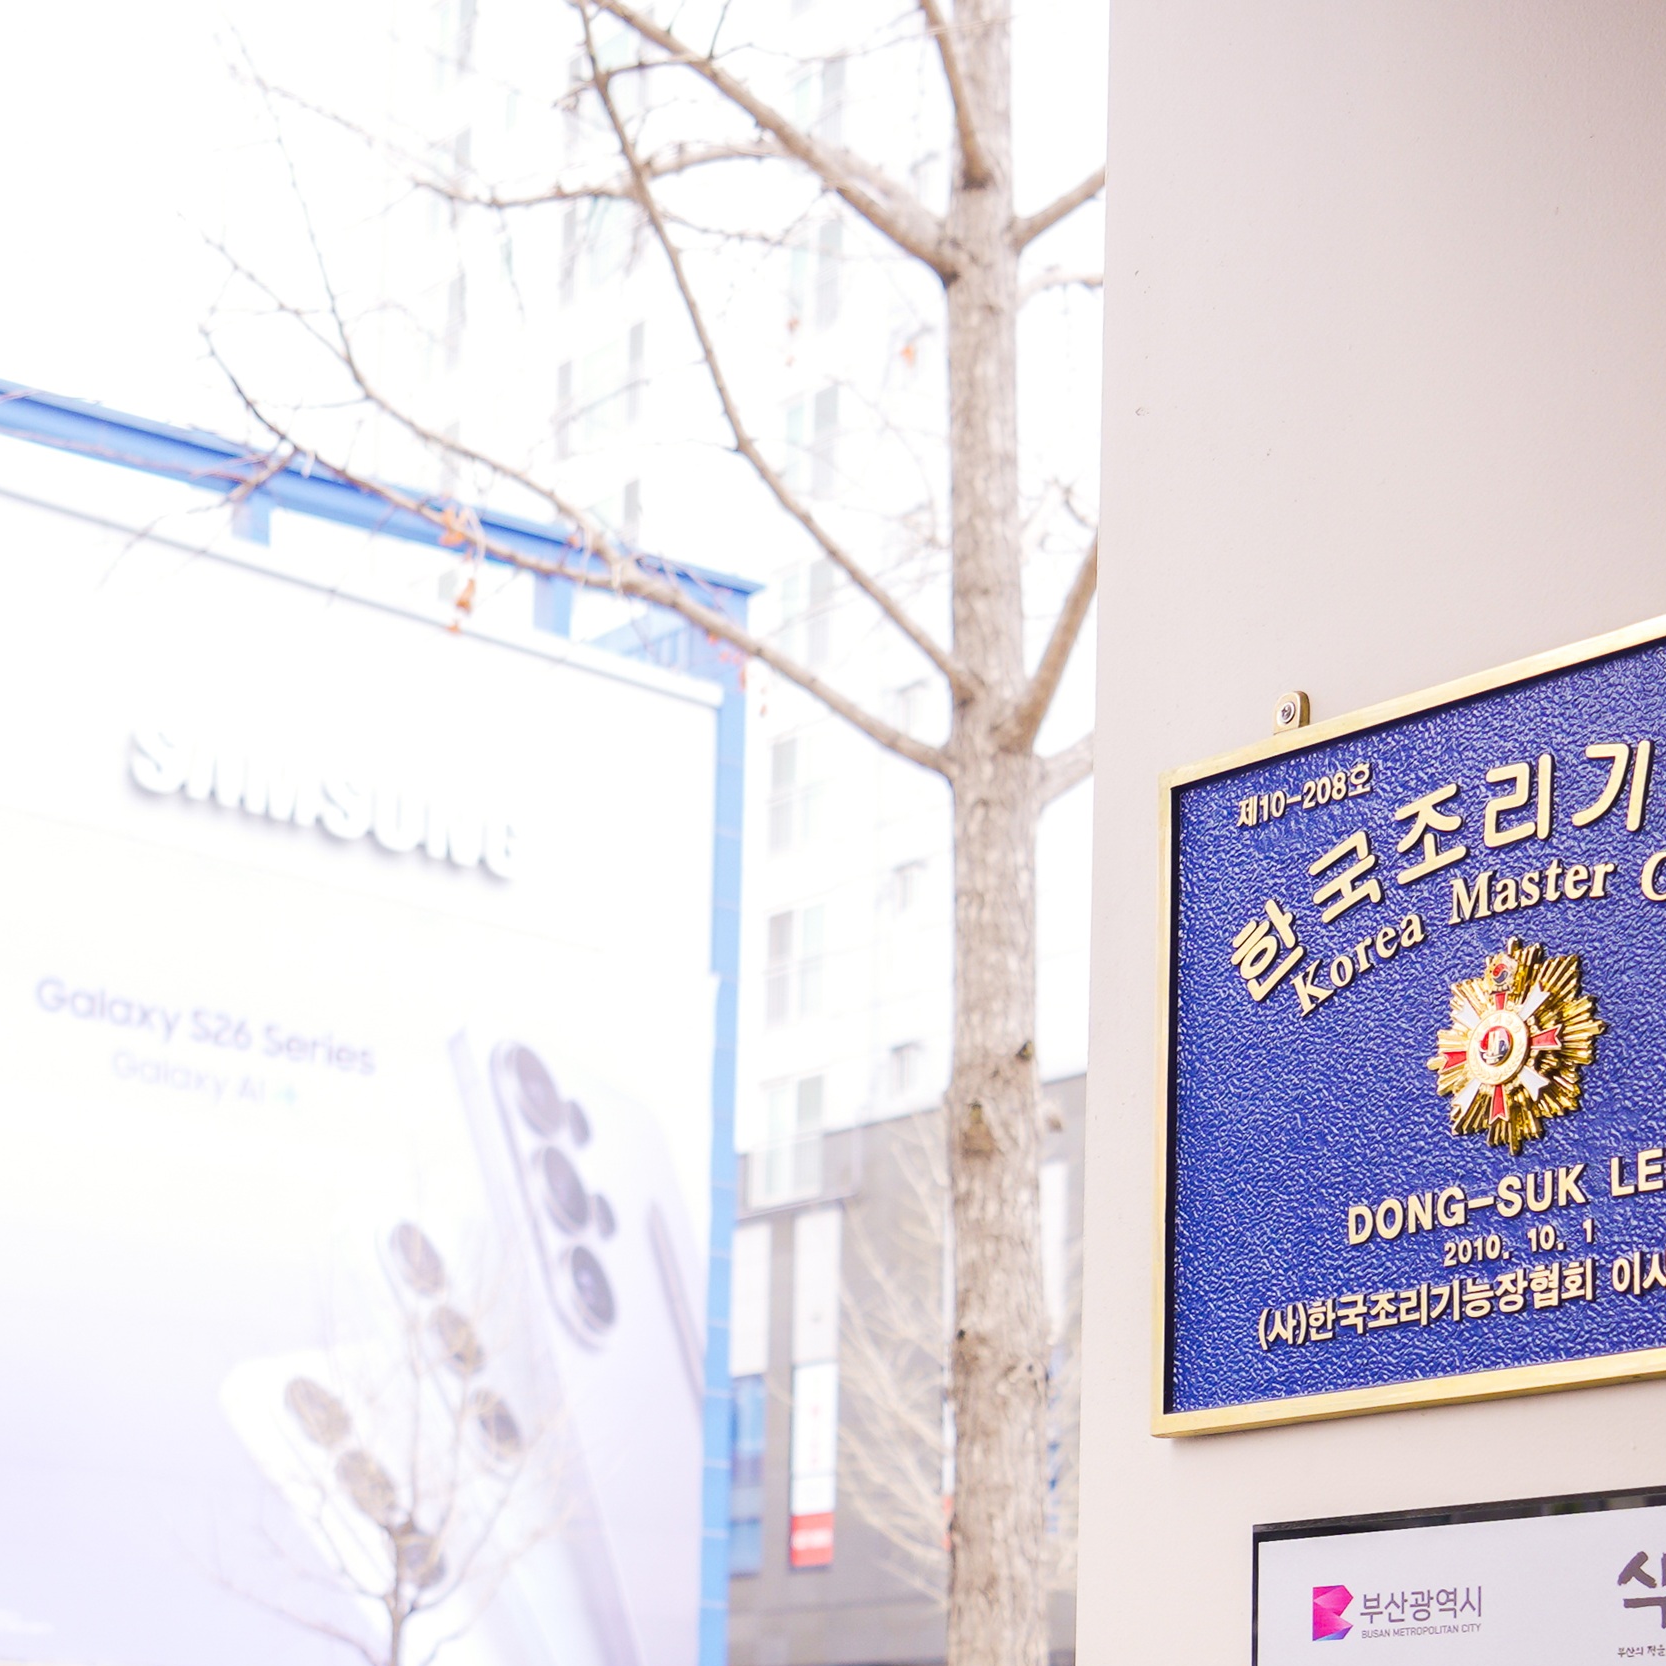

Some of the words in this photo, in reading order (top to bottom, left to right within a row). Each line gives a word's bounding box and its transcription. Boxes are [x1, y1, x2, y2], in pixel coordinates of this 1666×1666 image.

[128, 726, 521, 882] SAMSUNG
[1237, 762, 1374, 828] 제10-208호
[1293, 912, 1425, 1018] Korea
[1448, 856, 1618, 926] Master
[35, 975, 181, 1044] Galaxy
[189, 1006, 253, 1053] S26
[262, 1022, 378, 1077] Series
[111, 1048, 229, 1104] Galaxy
[236, 1075, 266, 1105] AI
[1347, 1162, 1588, 1246] DONG-SUK
[1443, 1235, 1512, 1267] 2010.
[1526, 1225, 1566, 1255] 10.
[1582, 1217, 1595, 1245] 1
[1257, 1258, 1596, 1352] (사)한국조리기능장협회
[1359, 1585, 1482, 1625] 부산광역시
[1361, 1628, 1391, 1639] BUSAN
[1392, 1624, 1459, 1637] METROPOLITAN
[1461, 1623, 1482, 1633] CITY
